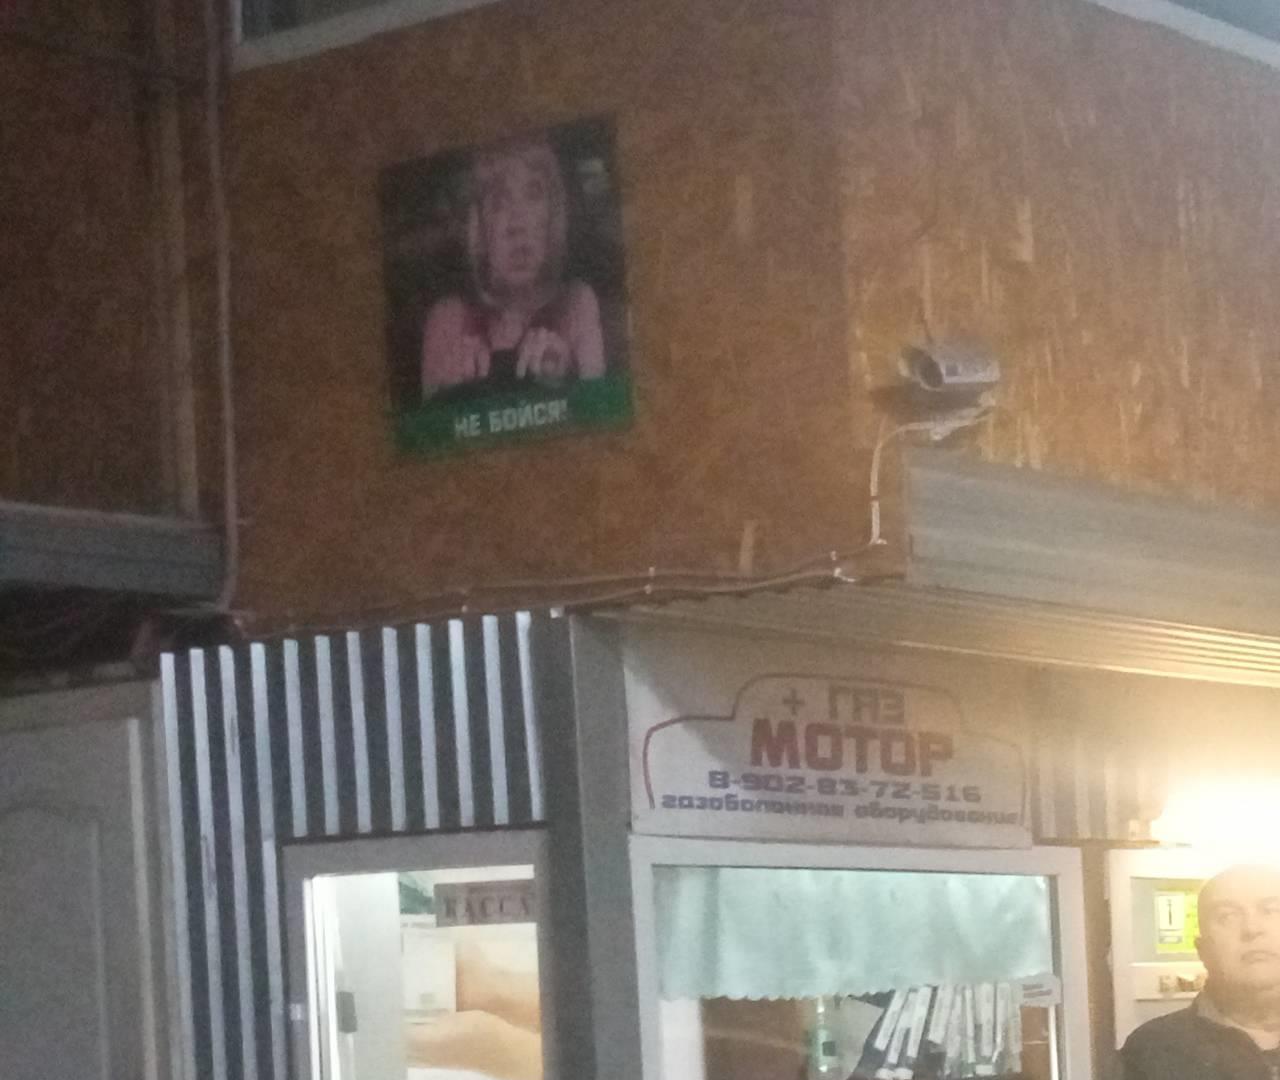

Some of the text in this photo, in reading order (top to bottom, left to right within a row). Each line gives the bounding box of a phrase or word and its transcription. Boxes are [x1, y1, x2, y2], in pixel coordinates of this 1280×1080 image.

[454, 399, 568, 438] НЕ БОЙСЯ!
[751, 717, 955, 777] МОТОР
[708, 770, 981, 803] 8-902-83-72-516
